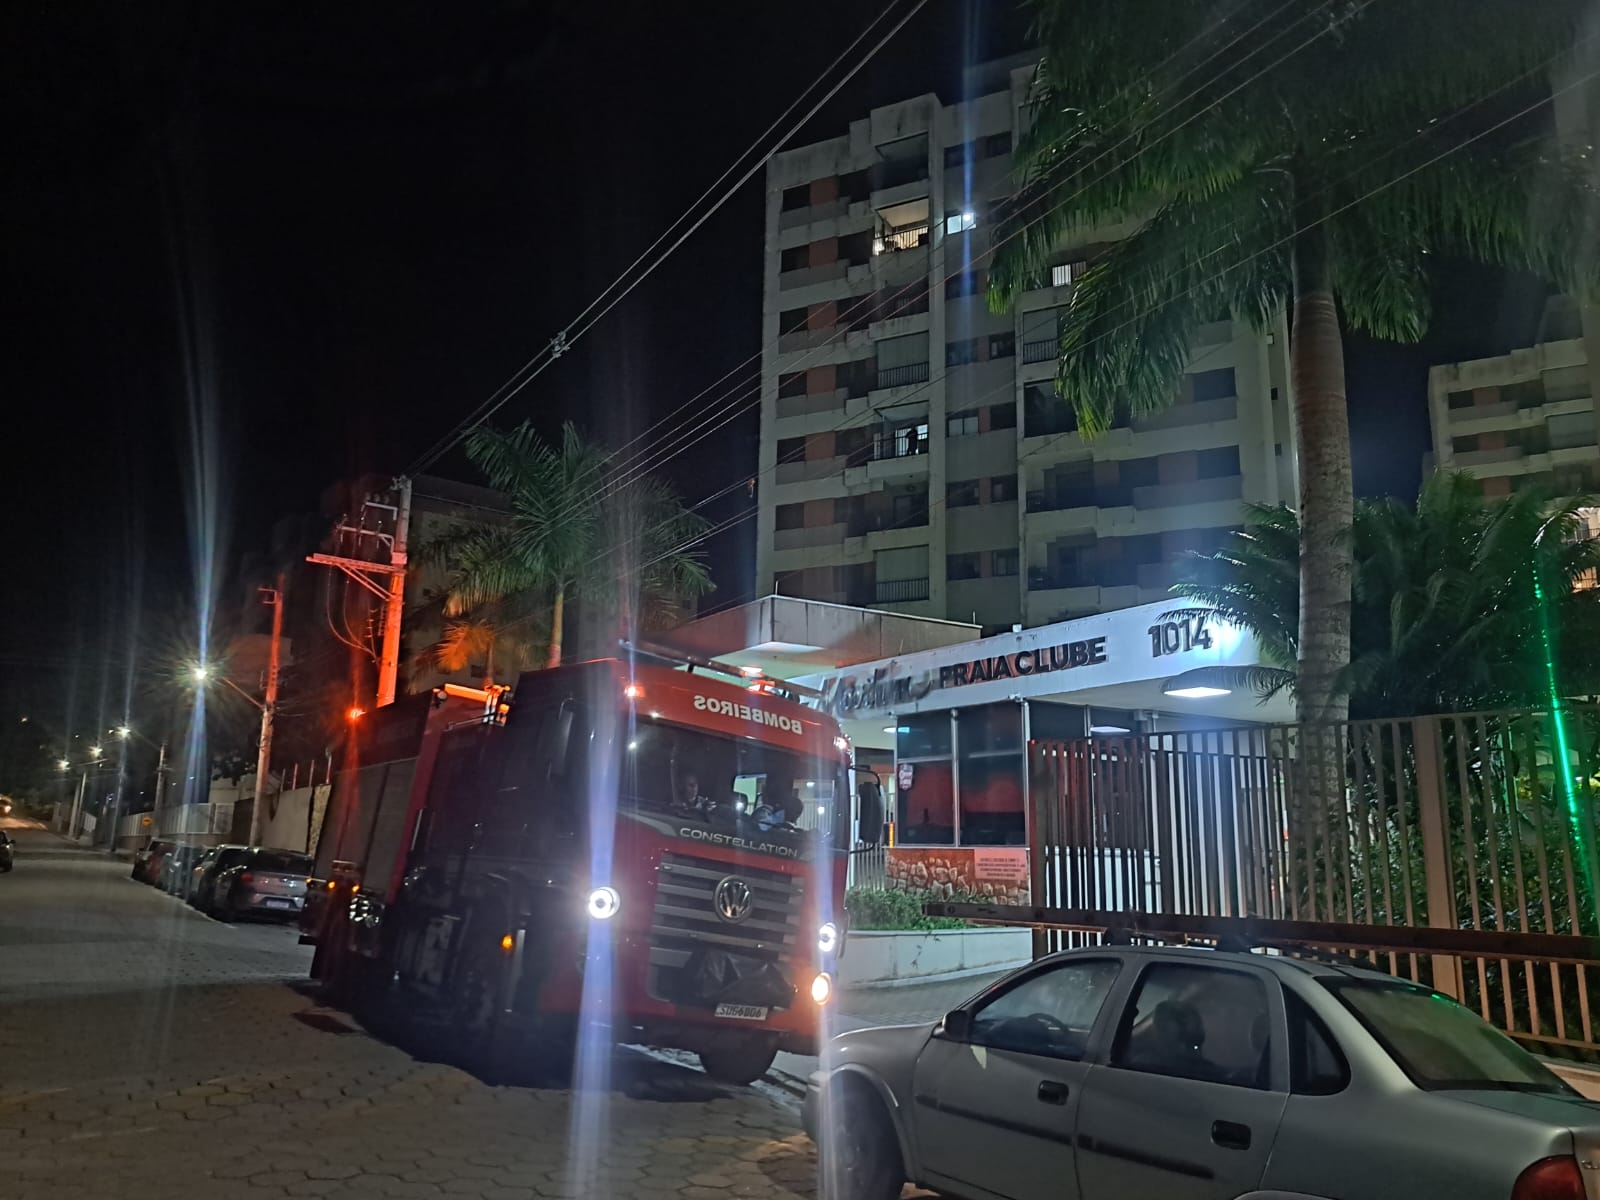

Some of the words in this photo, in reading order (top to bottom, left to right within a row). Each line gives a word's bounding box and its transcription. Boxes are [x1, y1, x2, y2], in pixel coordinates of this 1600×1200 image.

[1148, 616, 1213, 657] 1014
[940, 655, 1012, 688] PRAIA
[1015, 636, 1107, 675] CLUBE
[680, 827, 798, 857] CONSTELLATION
